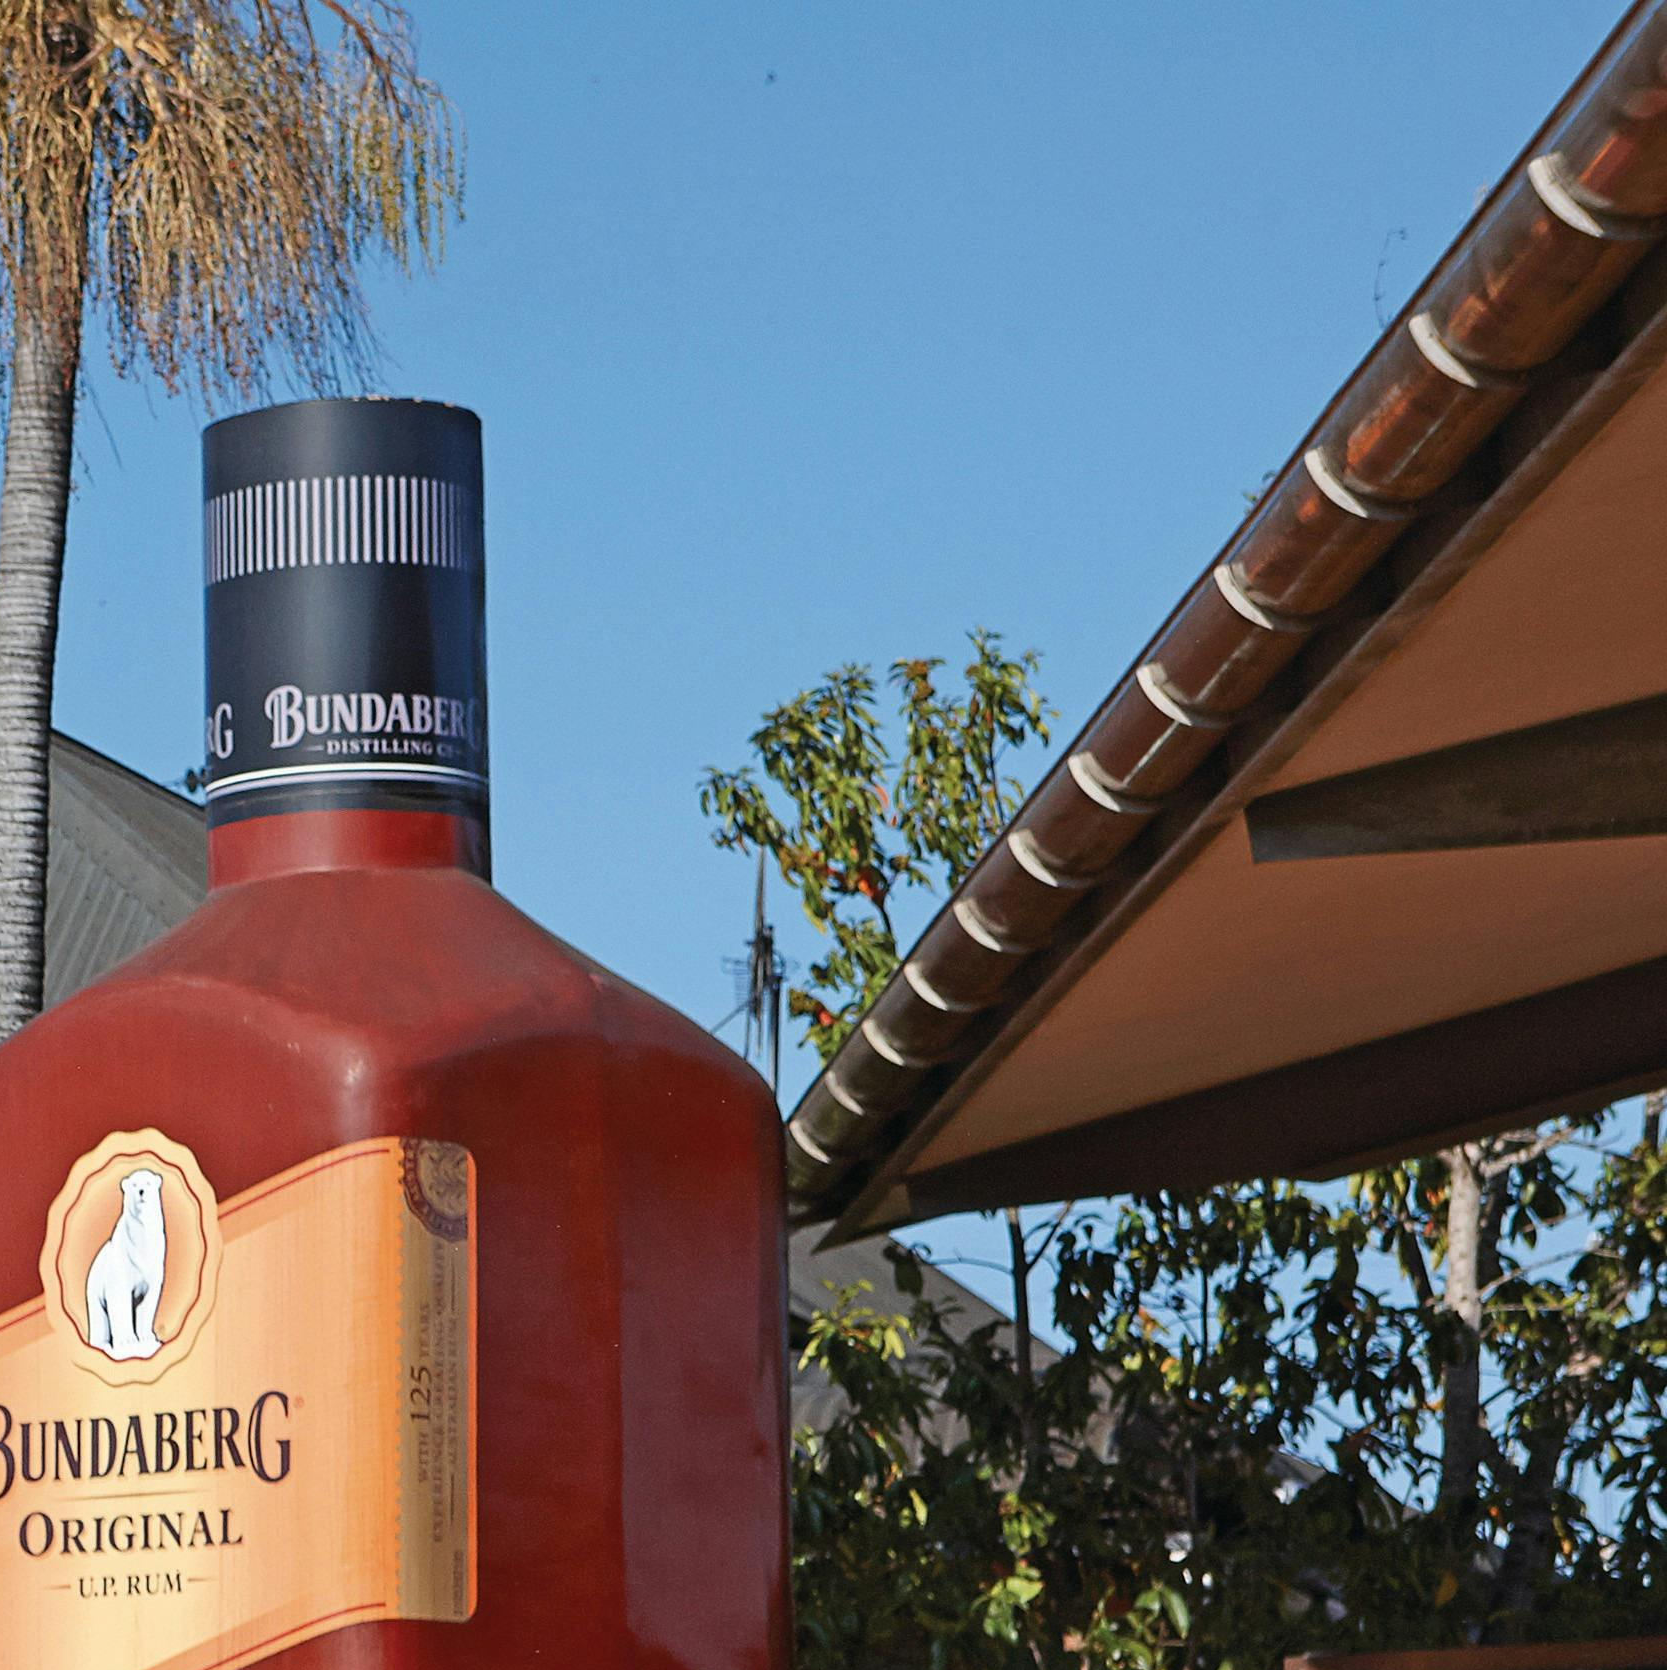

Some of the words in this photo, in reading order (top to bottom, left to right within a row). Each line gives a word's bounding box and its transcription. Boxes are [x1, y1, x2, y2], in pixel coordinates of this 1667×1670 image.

[327, 738, 433, 756] DISTILLING
[410, 1365, 432, 1424] 125
[19, 1507, 243, 1557] ORIGINAL
[126, 1573, 182, 1596] RUM
